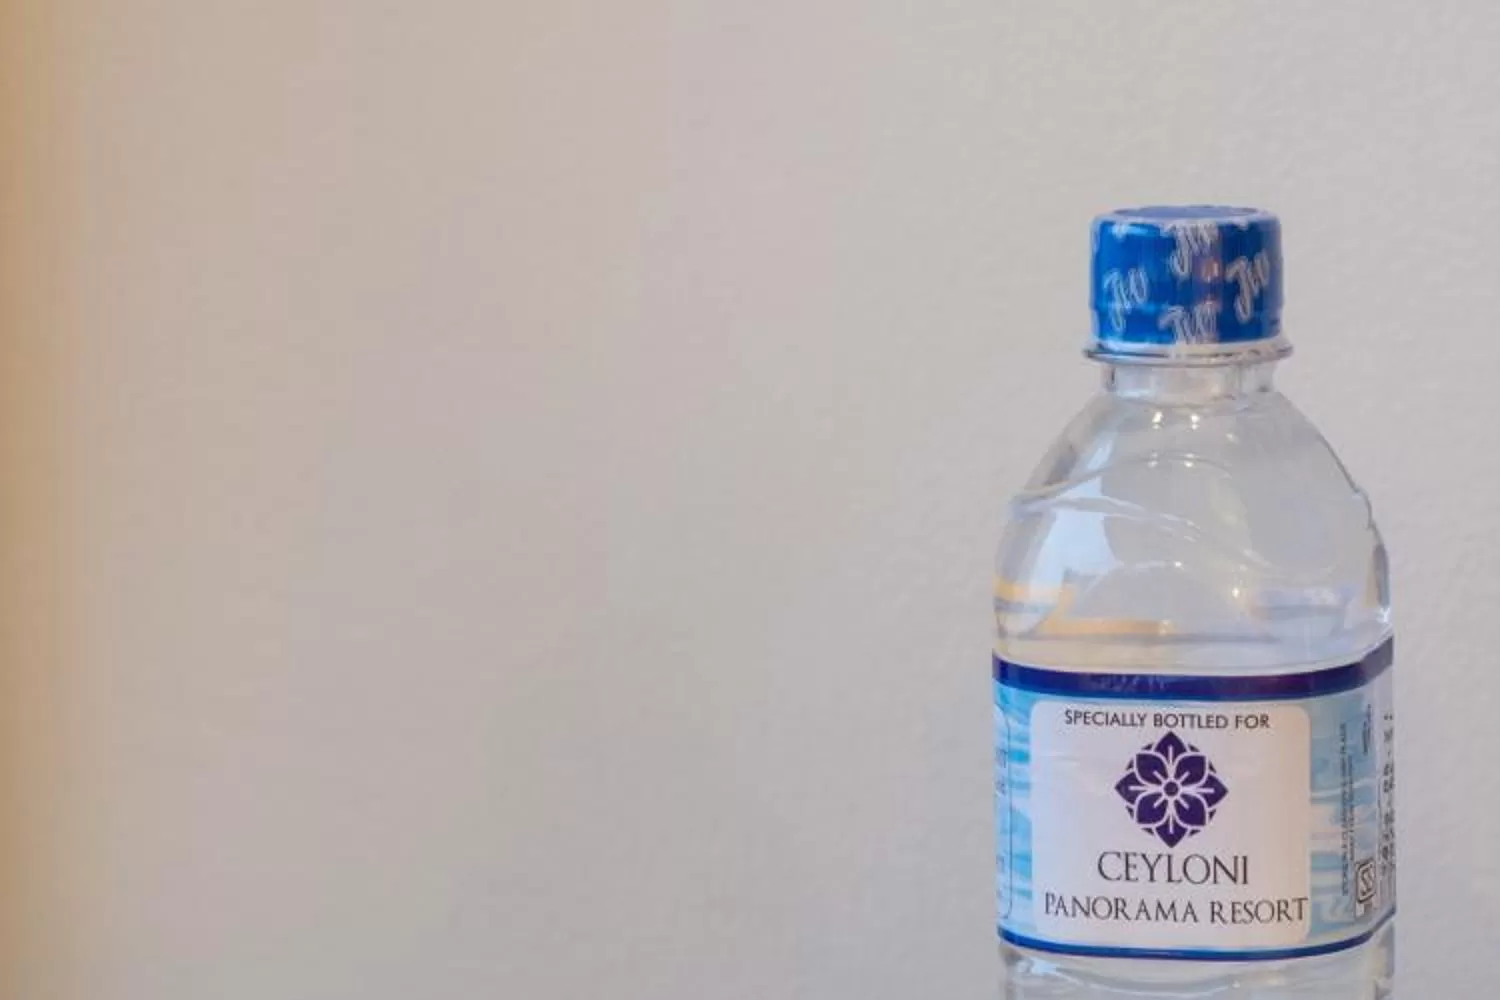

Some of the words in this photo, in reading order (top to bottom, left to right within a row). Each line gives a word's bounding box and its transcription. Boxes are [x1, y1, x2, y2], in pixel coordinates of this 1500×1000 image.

[1064, 708, 1147, 728] SPECIALLY
[1153, 713, 1229, 730] BOTTLED
[1234, 713, 1270, 730] FOR
[1097, 851, 1249, 886] CEYLONI
[1045, 891, 1199, 924] PANORAMA
[1209, 897, 1309, 925] RESORT
